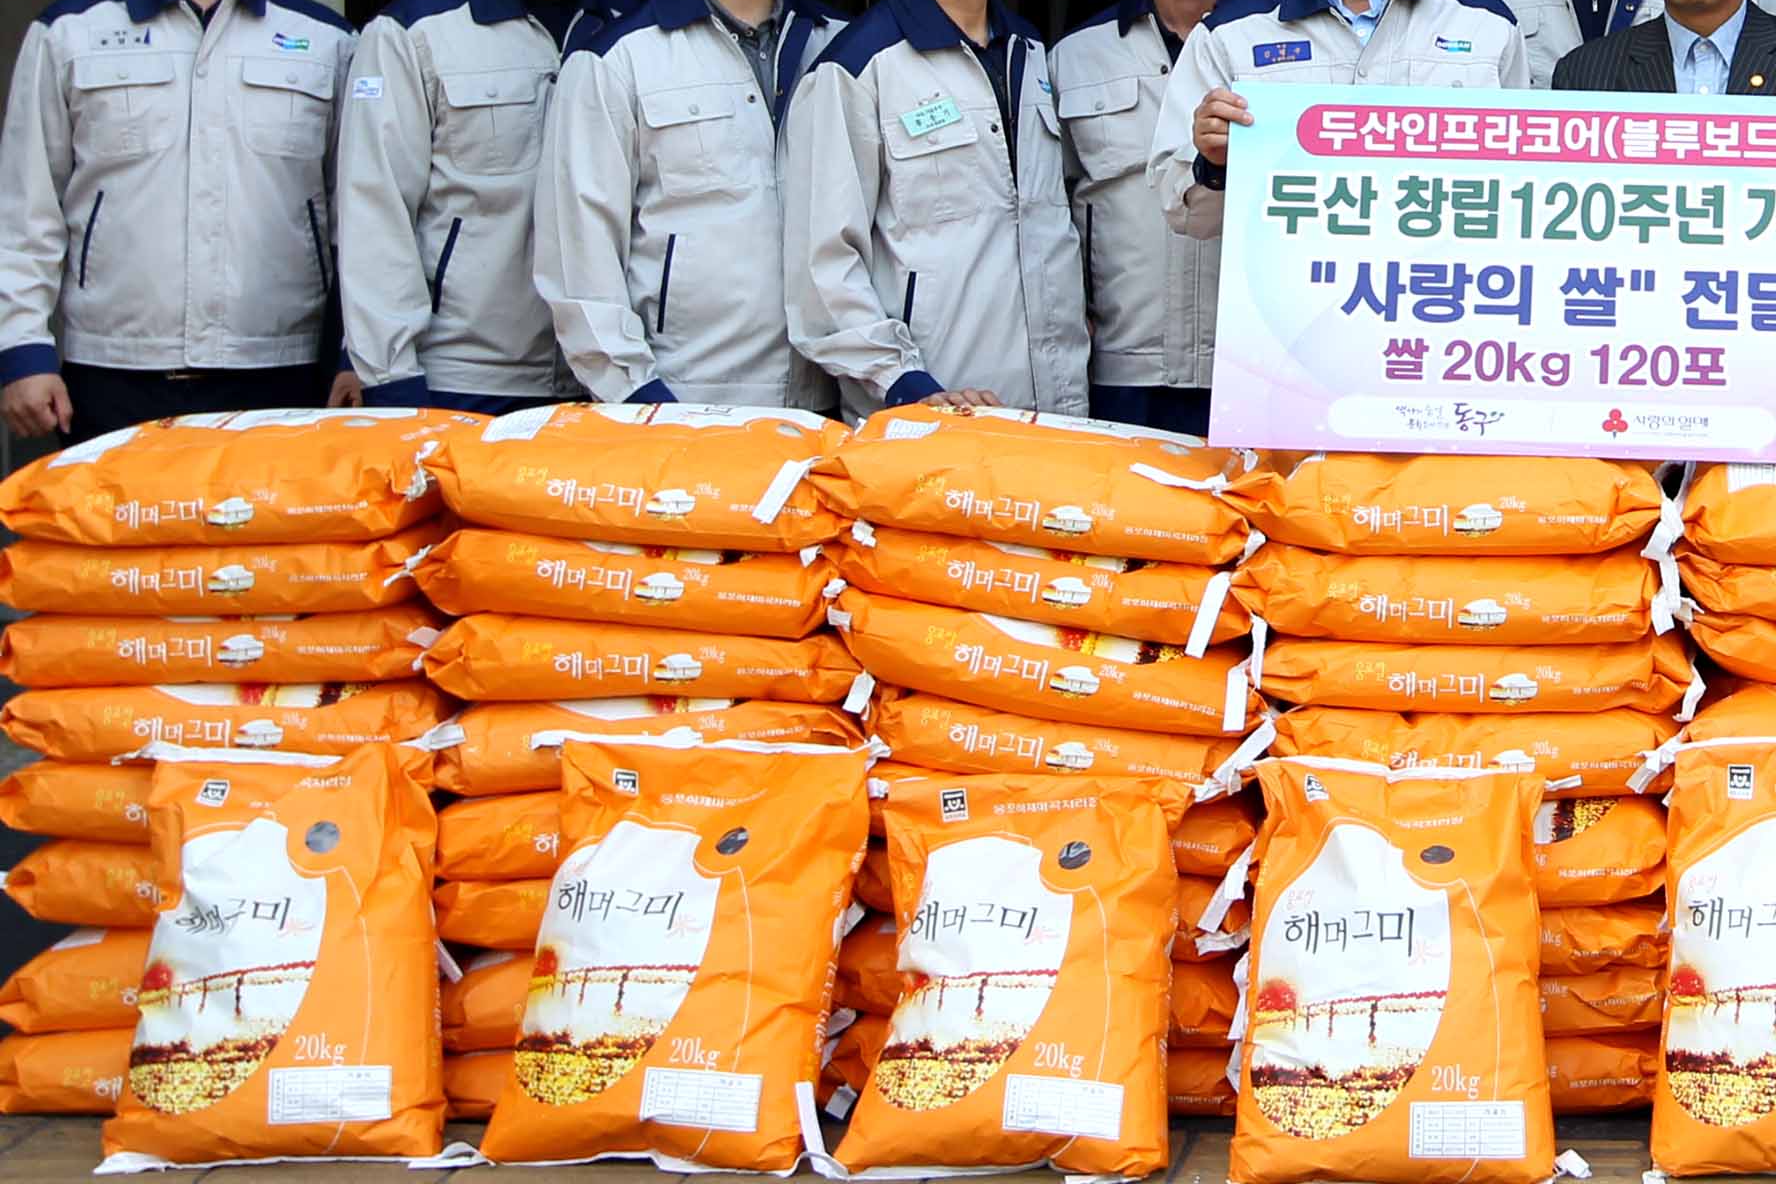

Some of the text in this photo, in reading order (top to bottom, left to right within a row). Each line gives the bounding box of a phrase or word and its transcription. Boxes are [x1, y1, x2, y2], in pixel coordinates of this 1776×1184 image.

[1268, 175, 1377, 236] 두산
[1395, 177, 1724, 246] 창립120주년
[1310, 261, 1531, 325] "사랑의
[1560, 268, 1655, 327] 쌀"
[1383, 338, 1727, 388] 쌀 20kg 120포
[1452, 402, 1490, 436] 동구
[115, 497, 205, 528] 해머그미
[547, 478, 644, 516] 해머그미
[945, 489, 1040, 533] 해머그미
[1353, 504, 1448, 536] 해머그미
[111, 565, 204, 596] 해머그미
[536, 559, 632, 595] 해머그미
[947, 559, 1040, 603] 해머그미
[1359, 595, 1454, 629] 해머그미
[117, 636, 212, 667] 해머그미
[553, 652, 649, 683] 해머그미
[954, 643, 1049, 690] 해머그미
[1387, 672, 1484, 704] 해머그미
[133, 717, 231, 749] 해머그미
[948, 724, 1044, 767] 해머그미
[558, 880, 683, 929] 해머그미
[910, 901, 1038, 942] 해머그미
[1284, 907, 1414, 957] 해머그미
[294, 1035, 347, 1063] 20kg
[669, 1039, 720, 1071] 20kg
[1033, 1043, 1084, 1078] 20kg
[1431, 1065, 1481, 1098] 20kg
